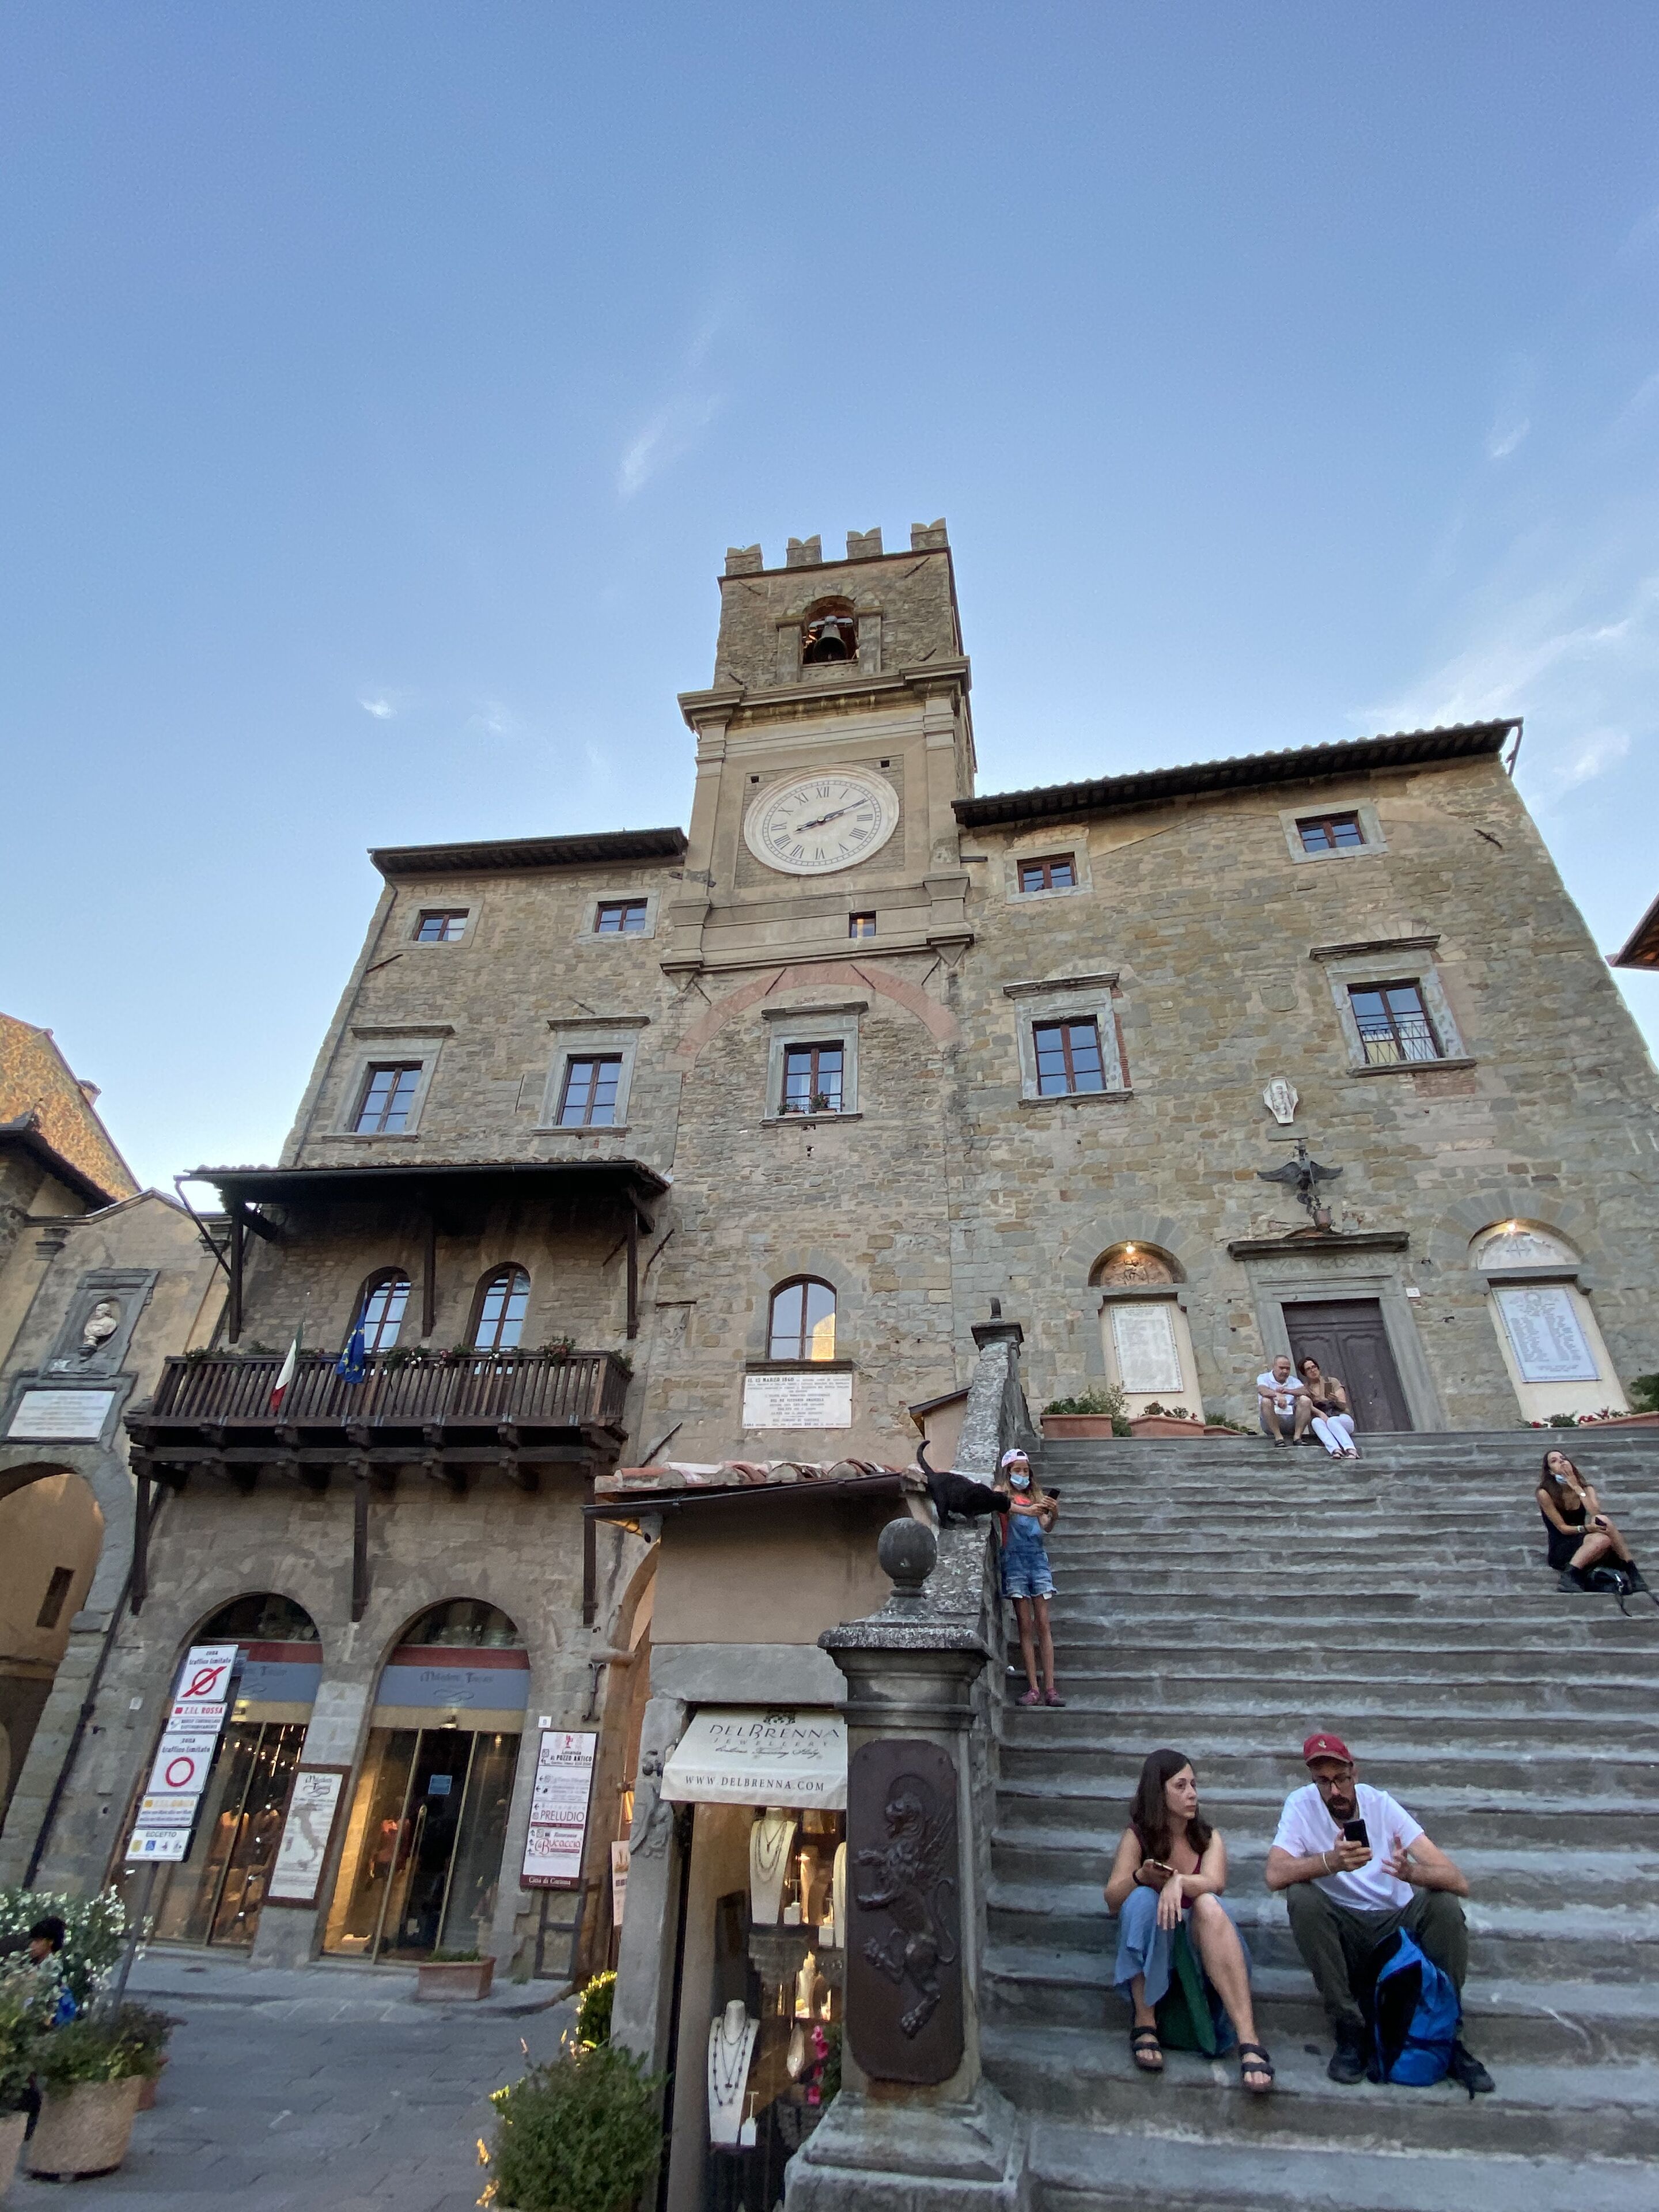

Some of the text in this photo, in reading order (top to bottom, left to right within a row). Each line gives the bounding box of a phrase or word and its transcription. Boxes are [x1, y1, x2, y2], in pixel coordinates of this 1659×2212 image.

[816, 786, 830, 799] XII
[794, 793, 809, 805] XI
[778, 807, 794, 816] X
[771, 822, 787, 831] IX
[774, 834, 792, 850] VIII
[790, 844, 805, 859] VII
[815, 848, 825, 860] VI
[838, 843, 849, 854] V
[201, 1706, 223, 1714] ROSSA
[714, 1737, 828, 1747] JEWELLERY
[540, 1810, 584, 1822] PRELUDIO
